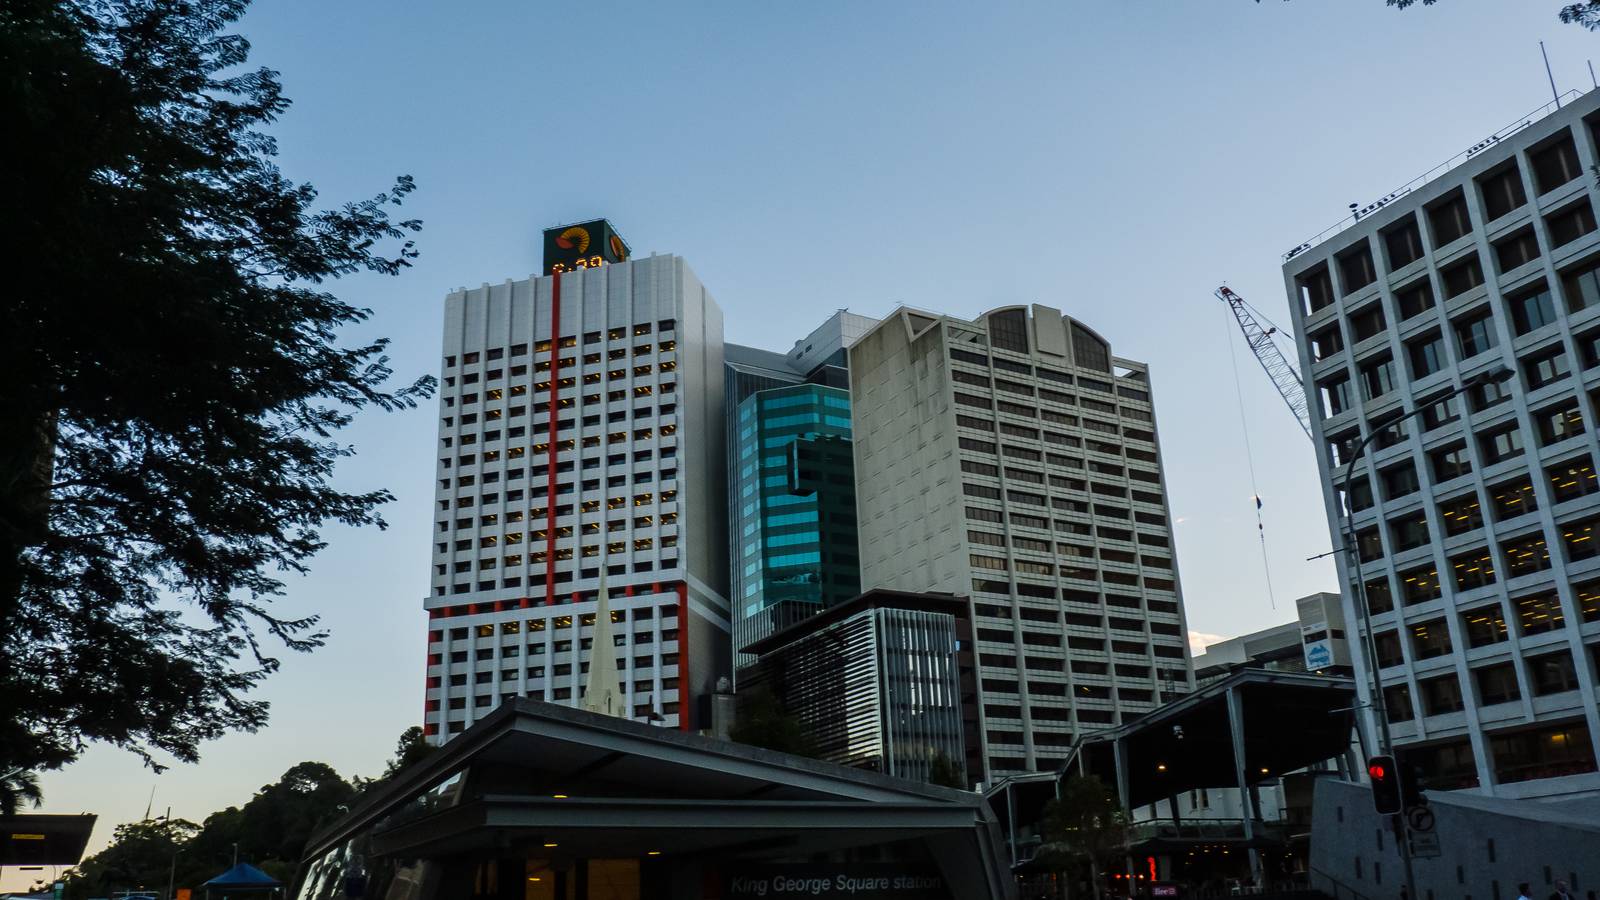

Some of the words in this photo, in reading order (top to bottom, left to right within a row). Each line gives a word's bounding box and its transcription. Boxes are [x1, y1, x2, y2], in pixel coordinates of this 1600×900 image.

[731, 877, 768, 896] King
[773, 876, 831, 895] George
[835, 875, 889, 894] Square
[893, 876, 941, 889] station
